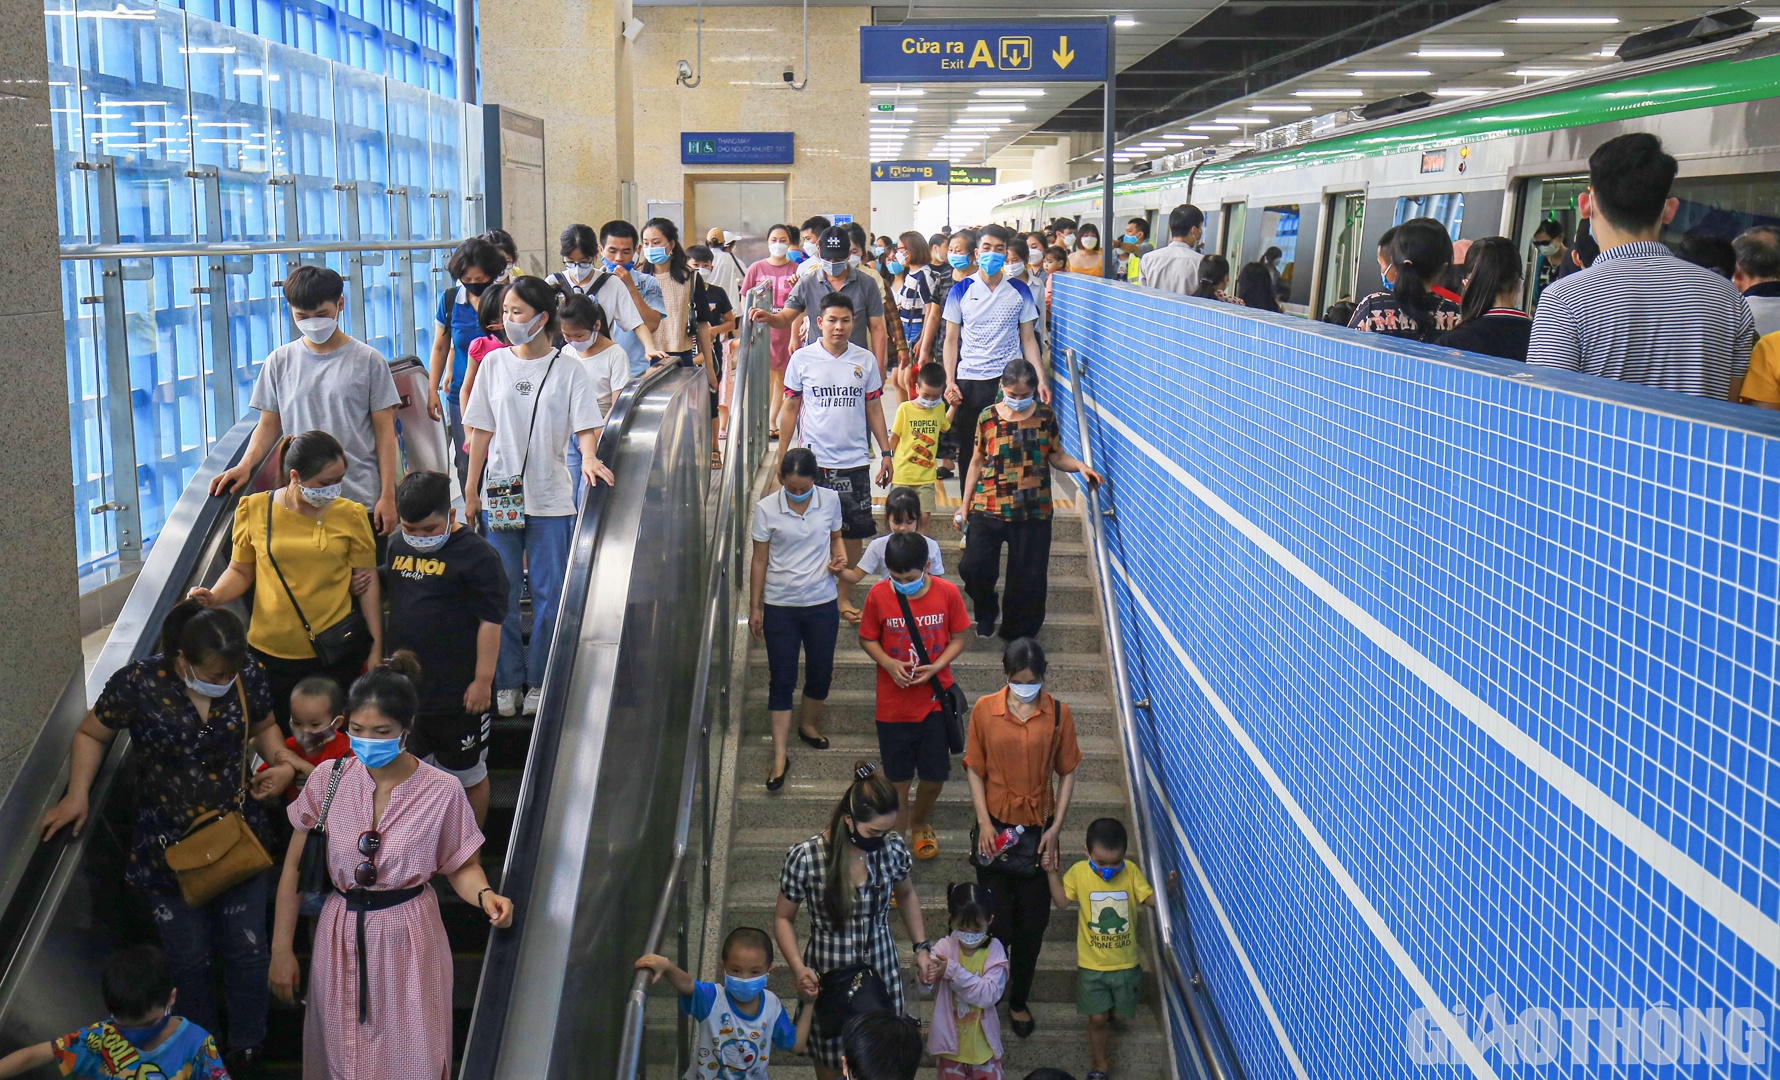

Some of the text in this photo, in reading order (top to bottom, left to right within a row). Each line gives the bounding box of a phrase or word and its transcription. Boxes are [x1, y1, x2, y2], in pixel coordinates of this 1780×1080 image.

[902, 37, 964, 54] Cửa ra
[967, 39, 995, 69] A
[941, 58, 964, 69] Exit
[924, 167, 933, 178] B
[812, 384, 864, 398] Emirates
[909, 419, 938, 428] TROPICAL
[912, 426, 935, 434] SKATER
[915, 613, 945, 627] YORK
[1090, 940, 1112, 948] STONE
